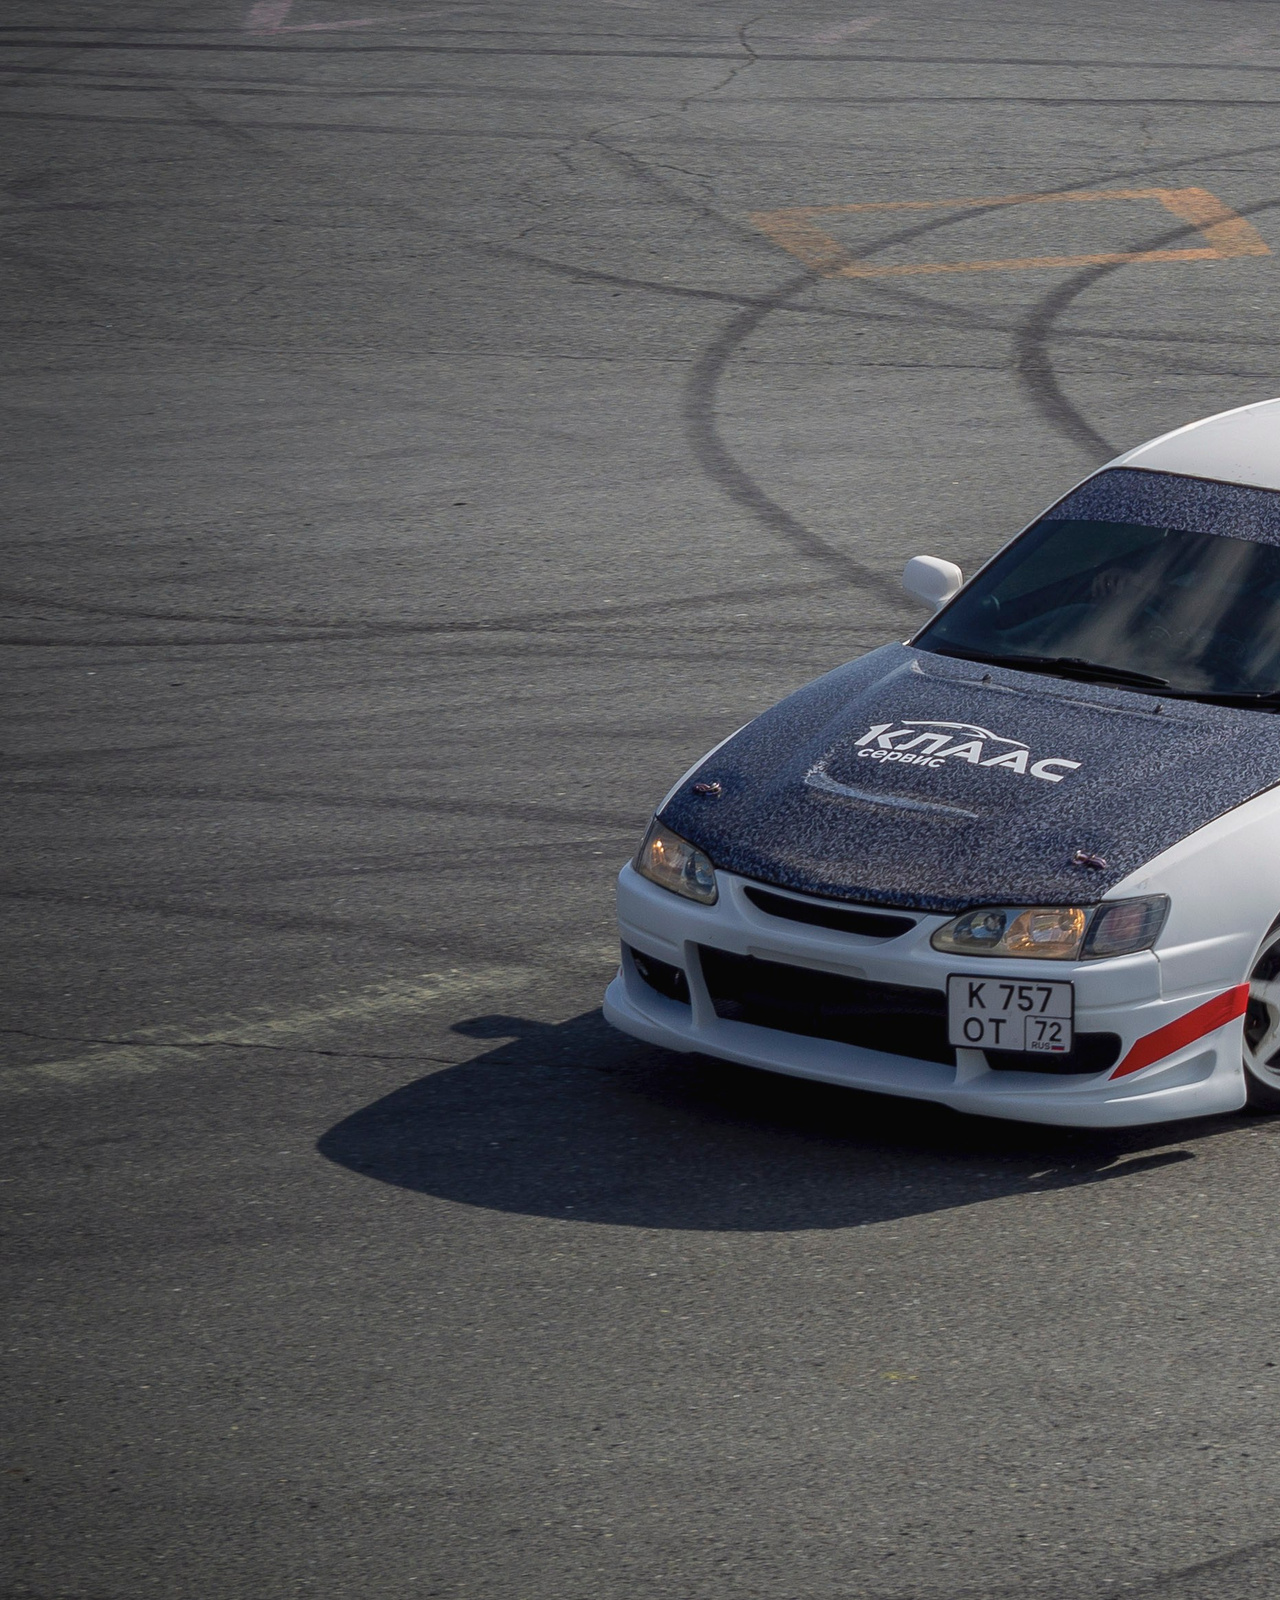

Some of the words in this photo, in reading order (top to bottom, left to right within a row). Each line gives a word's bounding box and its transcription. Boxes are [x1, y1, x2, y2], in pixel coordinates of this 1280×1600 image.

[857, 748, 947, 768] сервис
[968, 982, 986, 1009] К
[999, 984, 1053, 1013] 757
[963, 1017, 1007, 1044] ОТ
[1034, 1020, 1062, 1042] 72
[1031, 1041, 1051, 1050] RUS
